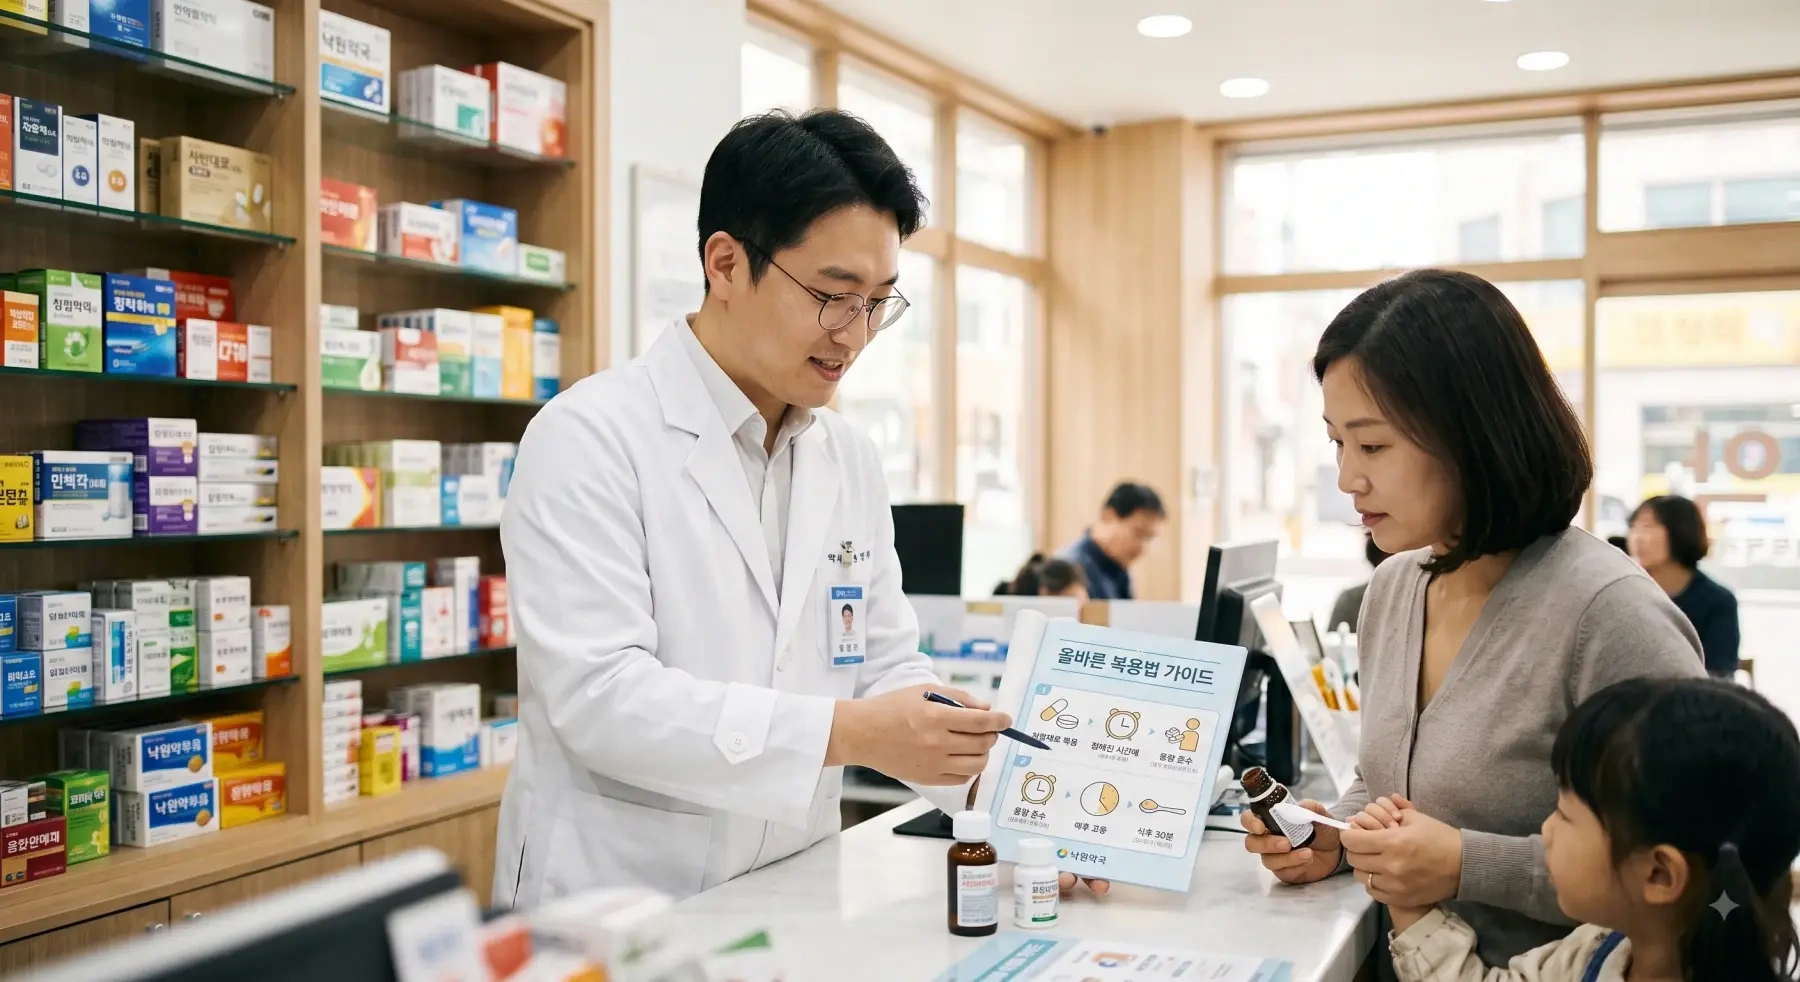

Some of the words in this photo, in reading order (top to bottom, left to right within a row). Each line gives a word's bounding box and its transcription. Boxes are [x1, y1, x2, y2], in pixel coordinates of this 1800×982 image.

[1058, 647, 1106, 670] 올바른
[1110, 655, 1161, 679] 복용법
[1164, 664, 1214, 685] 가이드
[1070, 851, 1107, 865] 낙원약국
